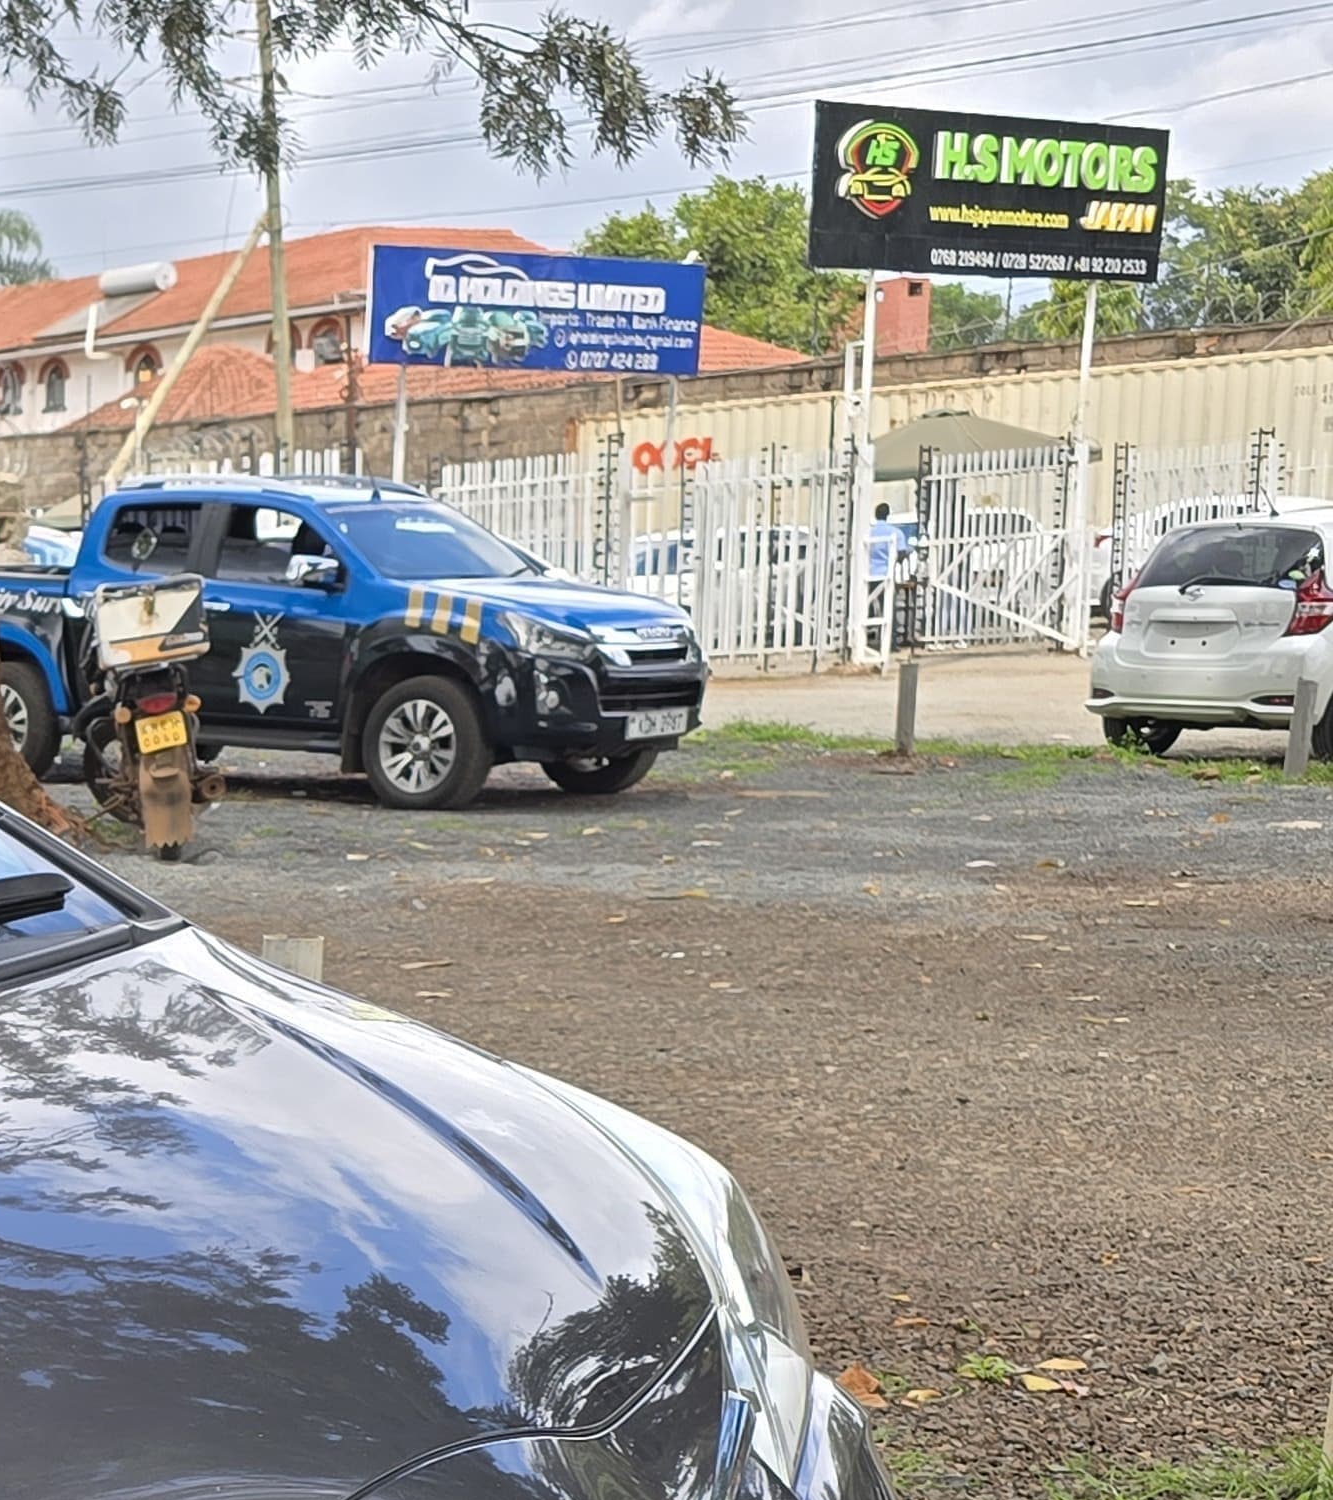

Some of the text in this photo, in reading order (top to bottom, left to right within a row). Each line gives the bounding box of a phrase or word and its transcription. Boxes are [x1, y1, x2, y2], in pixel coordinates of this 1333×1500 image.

[1000, 136, 1158, 193] MOTORS
[1079, 200, 1158, 233] JAPAN
[458, 276, 576, 309] HOLDINGS
[577, 283, 666, 313] LIMITED
